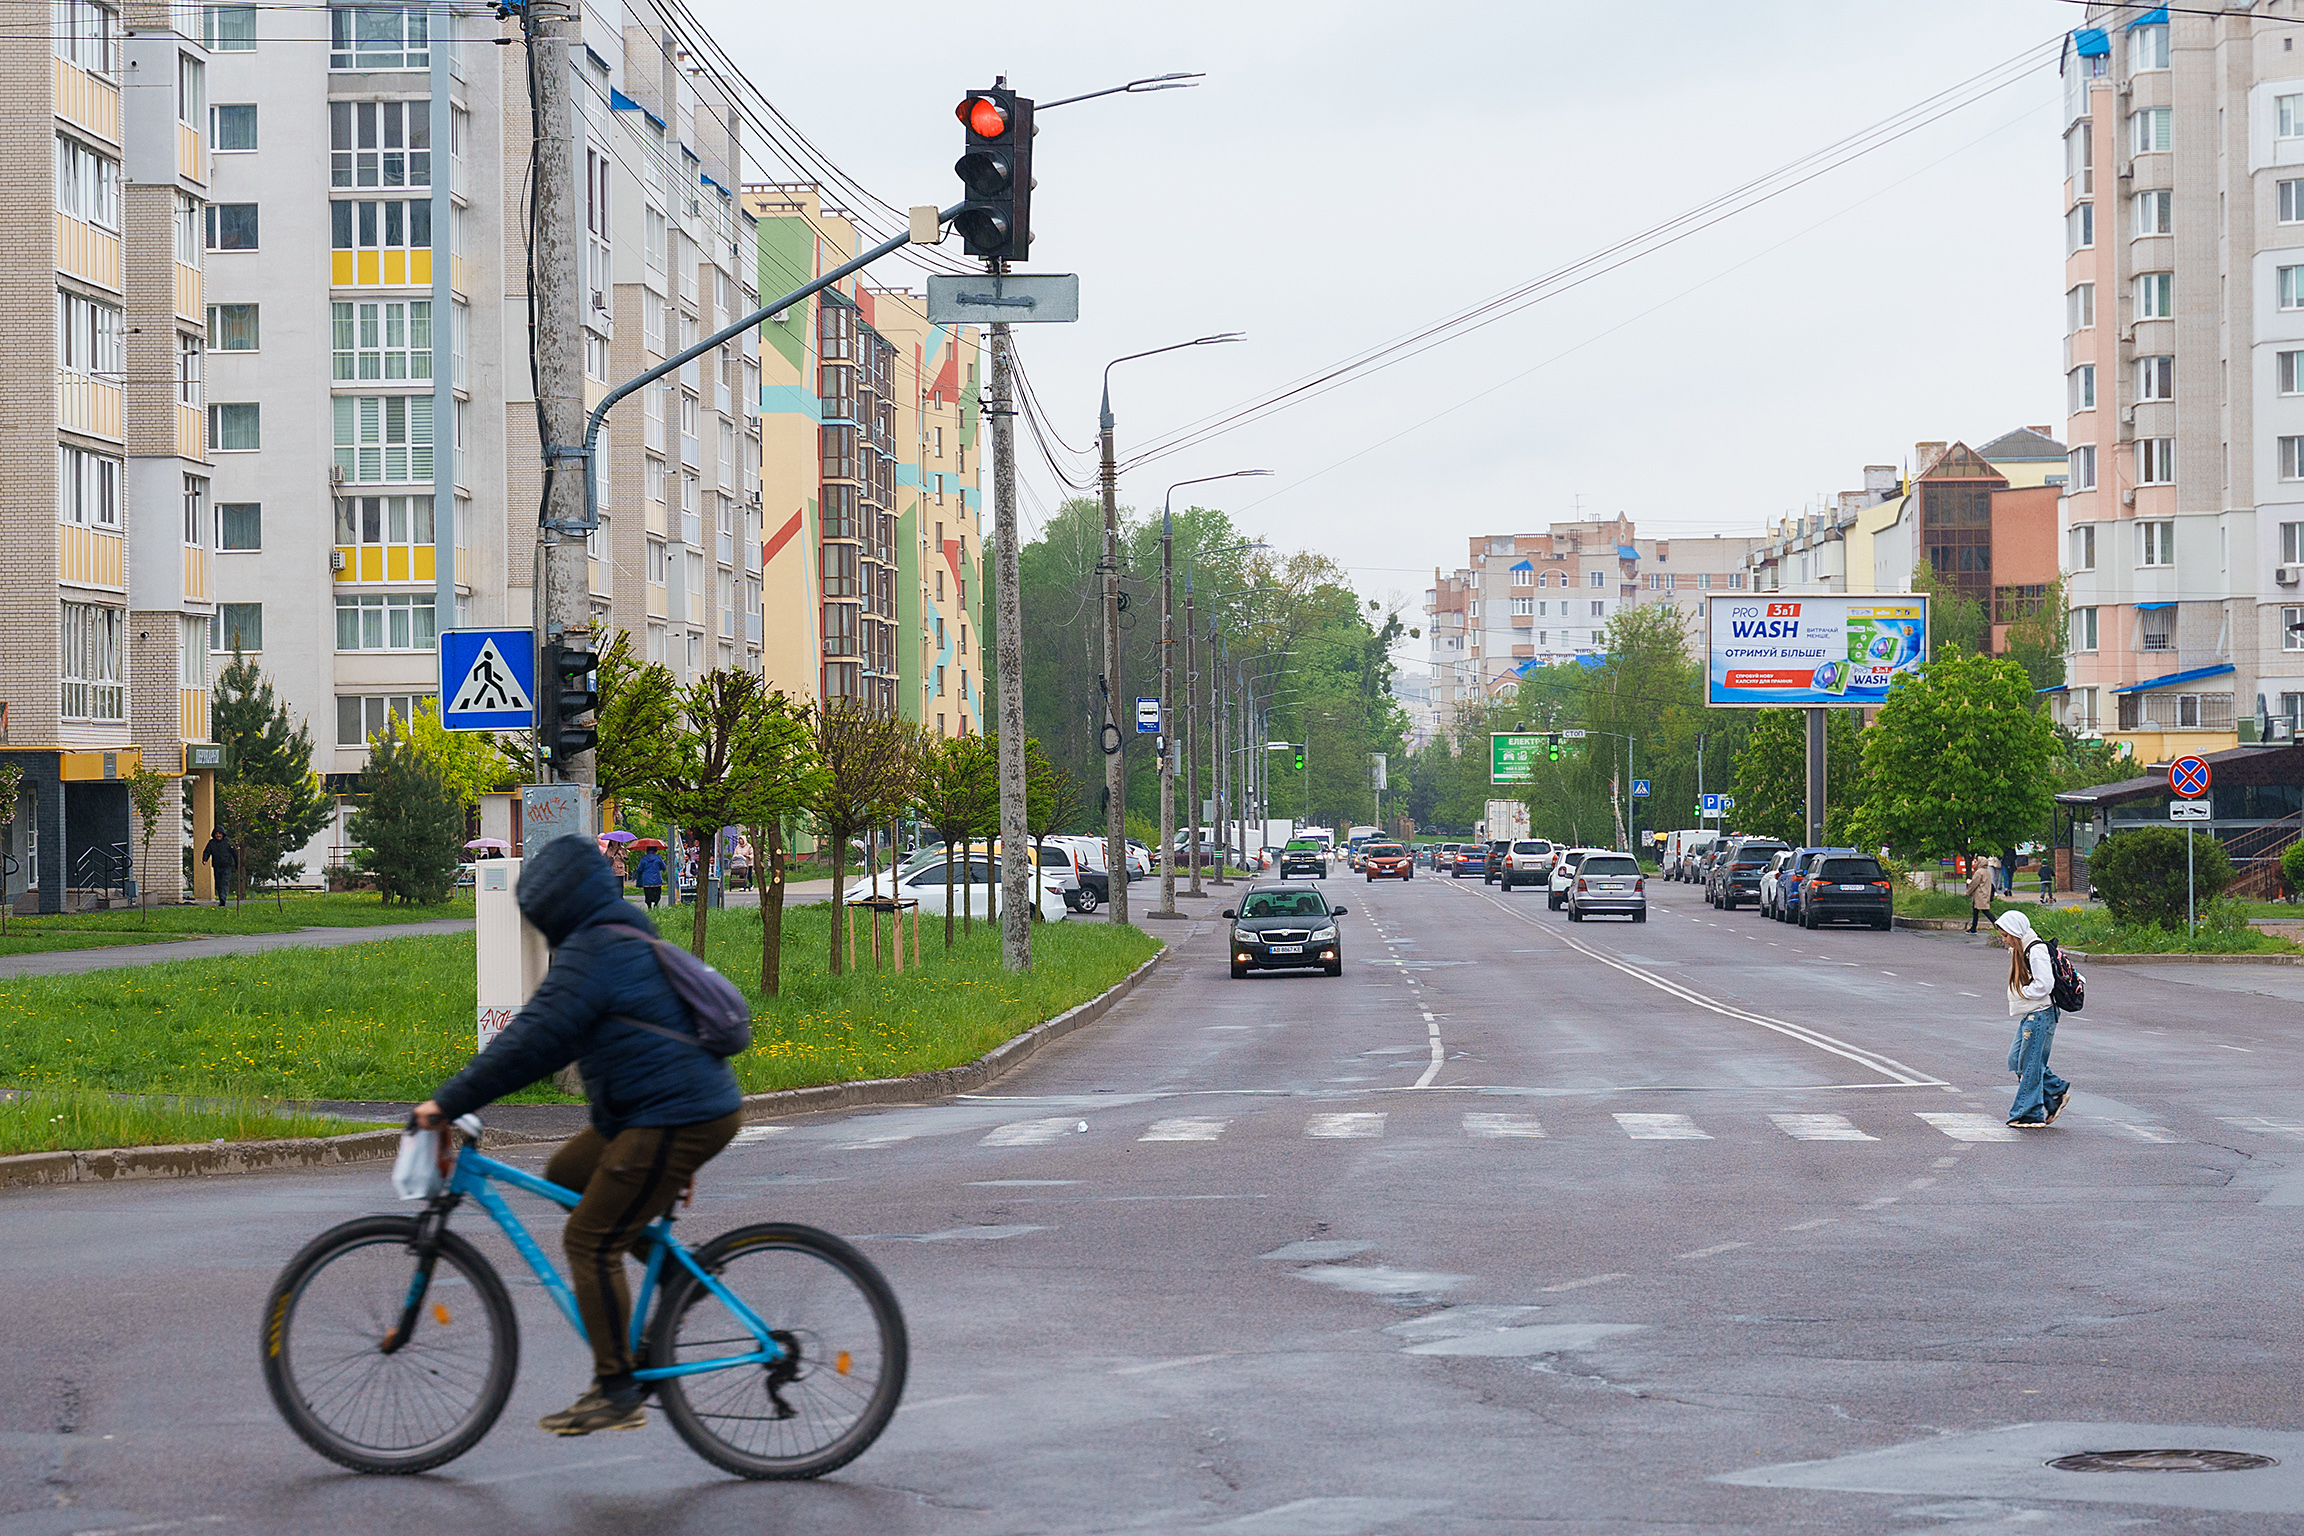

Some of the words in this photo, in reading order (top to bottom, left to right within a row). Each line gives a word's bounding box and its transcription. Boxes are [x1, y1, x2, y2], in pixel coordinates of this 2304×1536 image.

[1732, 607, 1759, 618] PRO
[1732, 620, 1799, 639] WASH
[1725, 647, 1777, 658] ОТРИМУЙ
[1780, 648, 1826, 658] БІЛЬШЕ!
[1854, 674, 1888, 685] WASH
[1707, 797, 1715, 808] P
